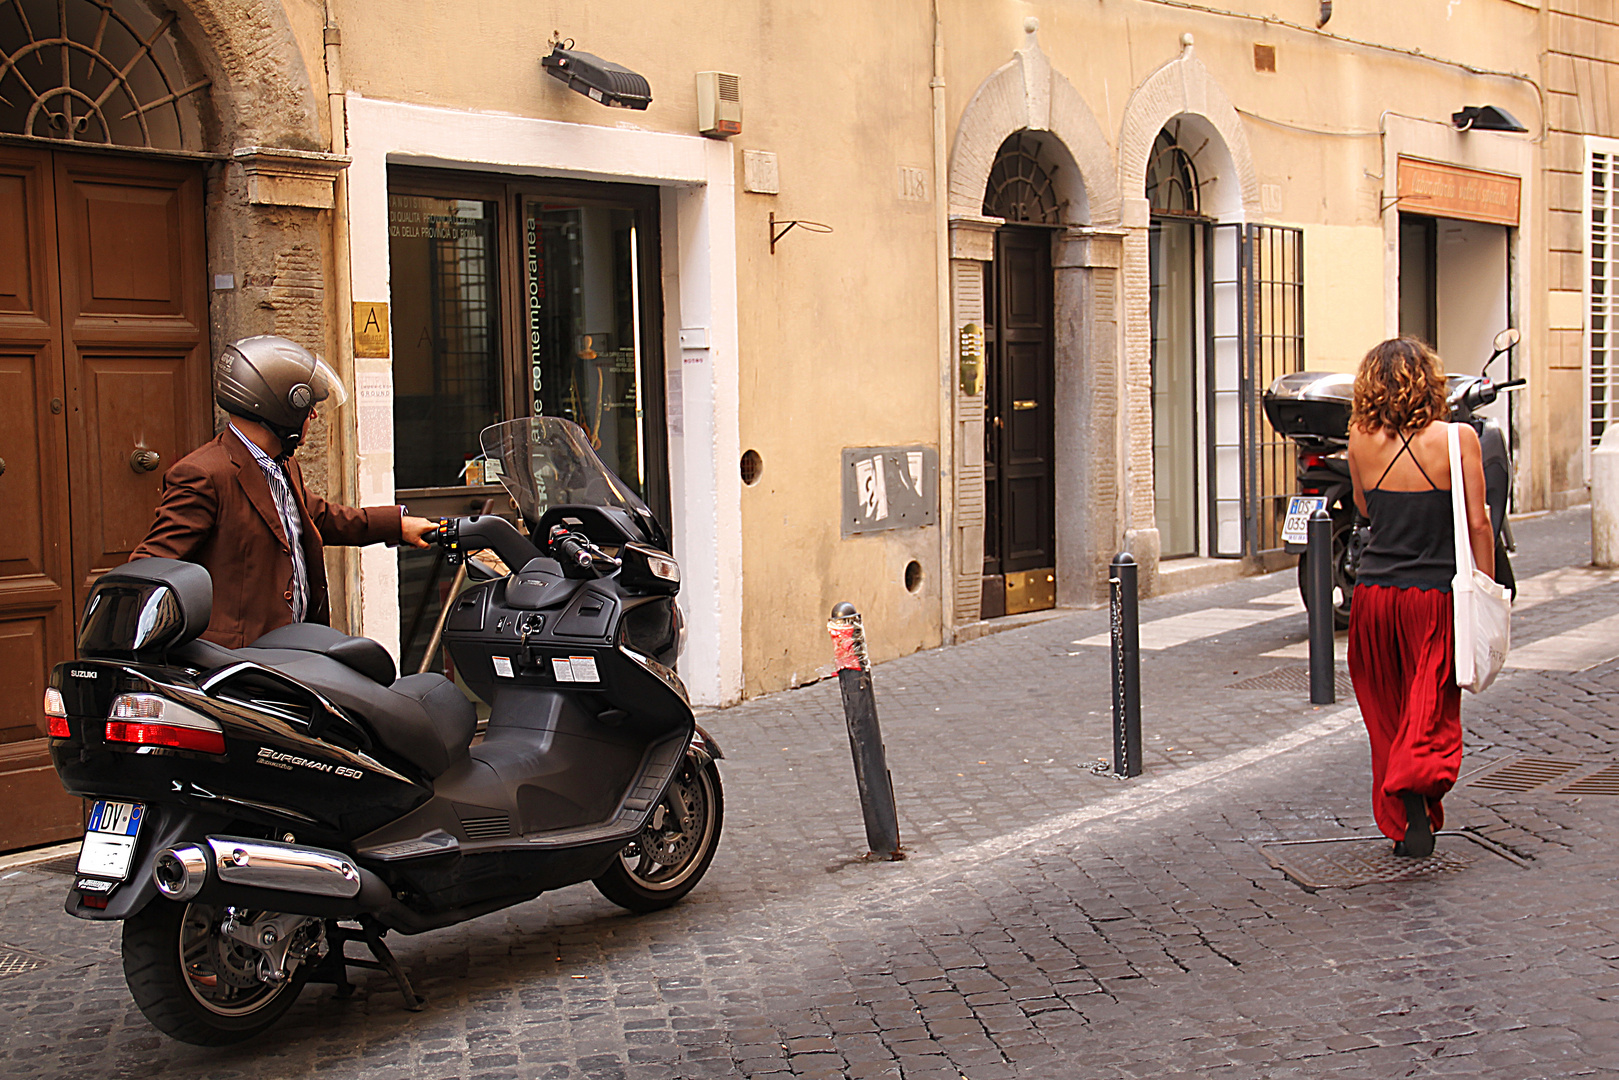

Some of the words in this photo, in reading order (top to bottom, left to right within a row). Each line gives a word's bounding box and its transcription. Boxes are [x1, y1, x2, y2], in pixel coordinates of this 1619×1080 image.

[902, 169, 925, 198] 118
[402, 226, 420, 238] DELLA
[421, 227, 452, 239] PROVINCIA
[527, 217, 542, 392] contemporanea
[363, 307, 381, 333] A
[71, 669, 98, 679] SUZUKI
[257, 746, 333, 773] BURGMAN
[334, 765, 364, 780] 650
[101, 802, 126, 832] DV
